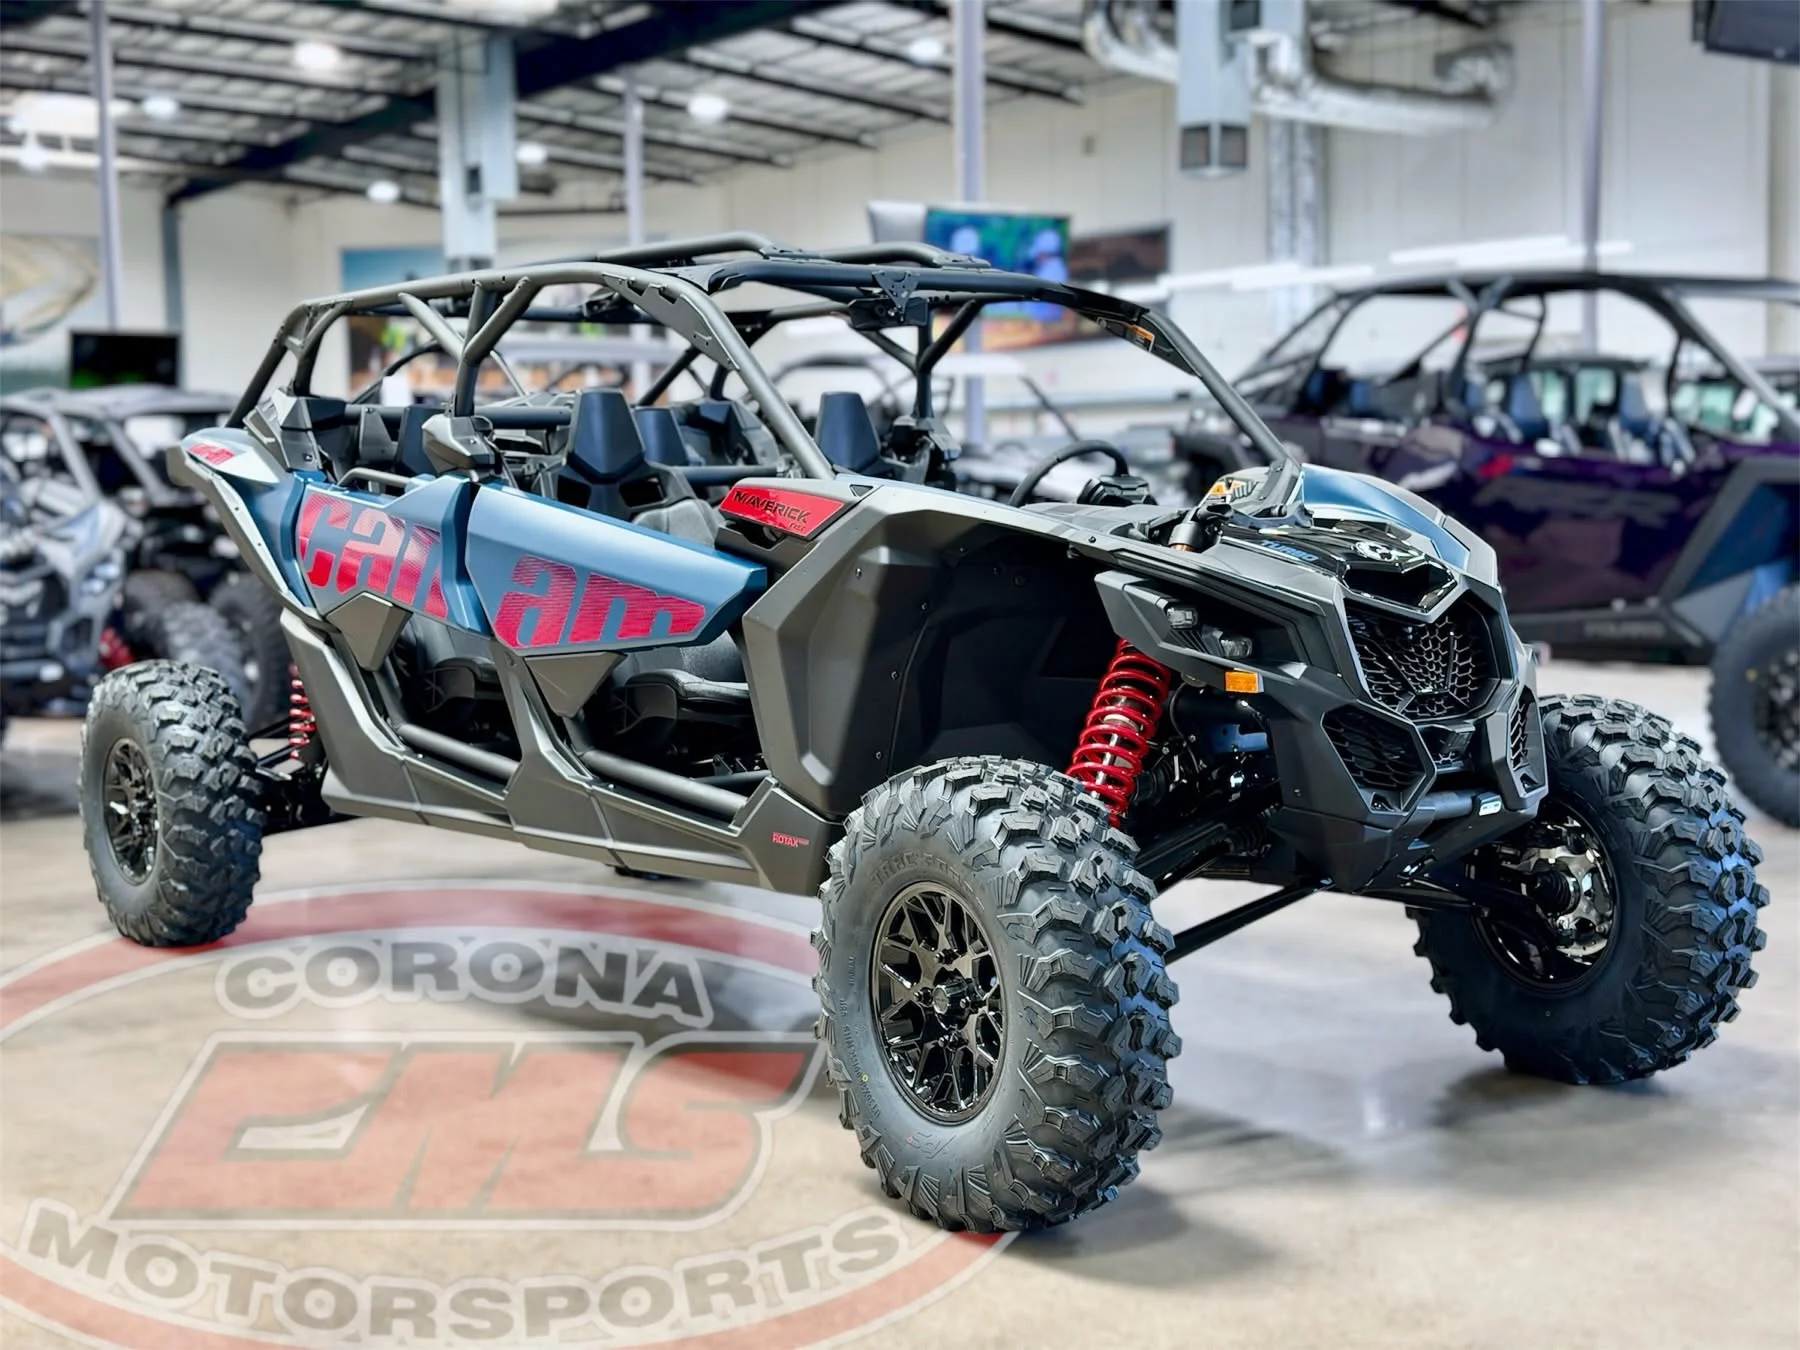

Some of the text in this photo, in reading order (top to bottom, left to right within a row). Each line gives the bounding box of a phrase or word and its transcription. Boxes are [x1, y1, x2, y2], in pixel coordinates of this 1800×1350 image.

[733, 490, 812, 524] MAVERICK
[772, 832, 799, 848] ROTAX
[224, 940, 706, 1018] CORONA
[26, 1207, 900, 1341] MOTORSPORTS
